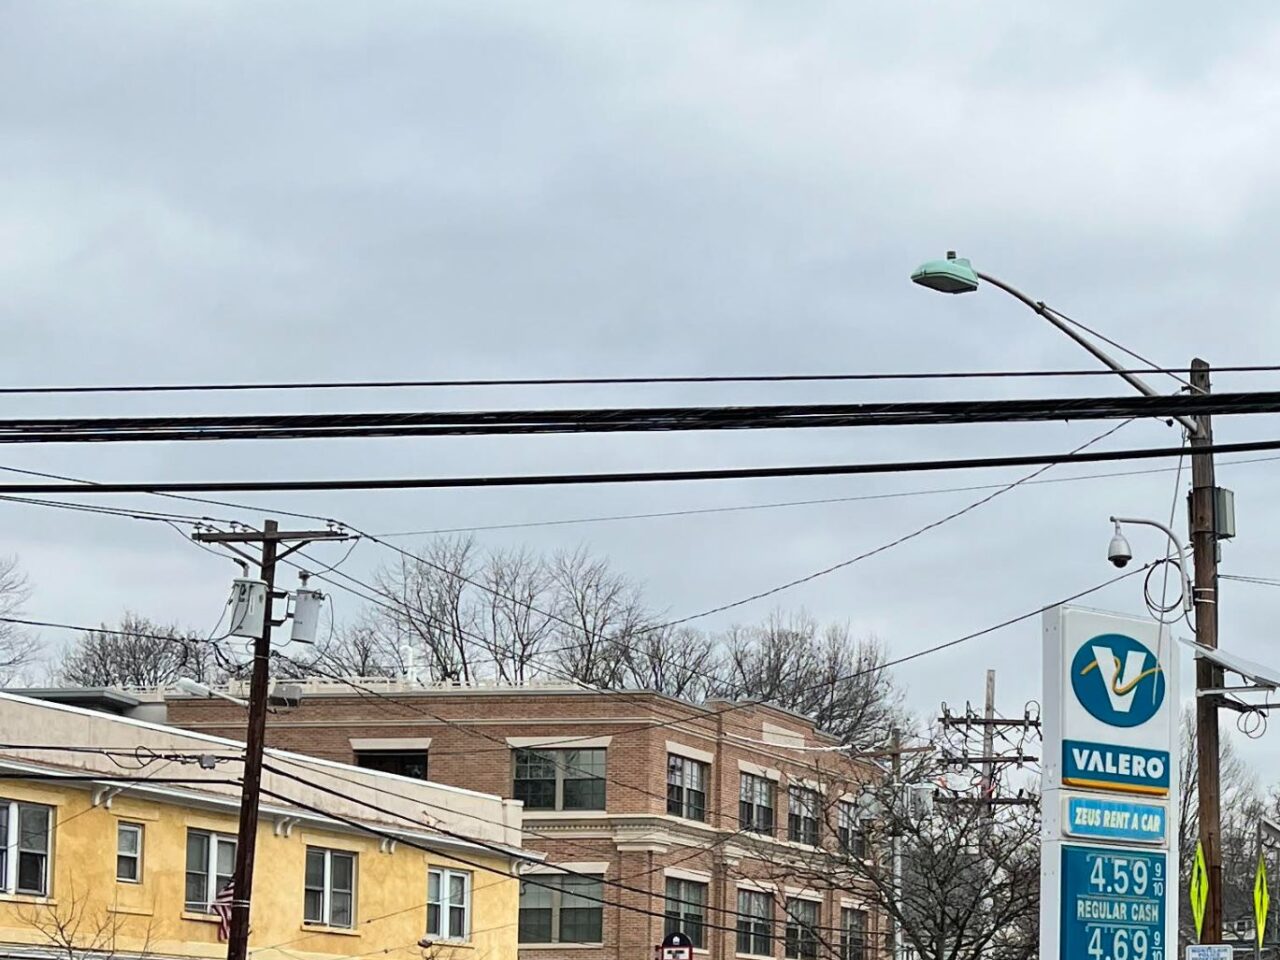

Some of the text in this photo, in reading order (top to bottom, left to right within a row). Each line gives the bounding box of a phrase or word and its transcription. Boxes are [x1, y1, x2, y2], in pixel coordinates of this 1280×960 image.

[1072, 748, 1164, 779] VALERO
[1075, 807, 1161, 833] ZEUS RENT A CAR
[1090, 857, 1148, 895] 4.59
[1077, 900, 1159, 922] REGULAR CASH
